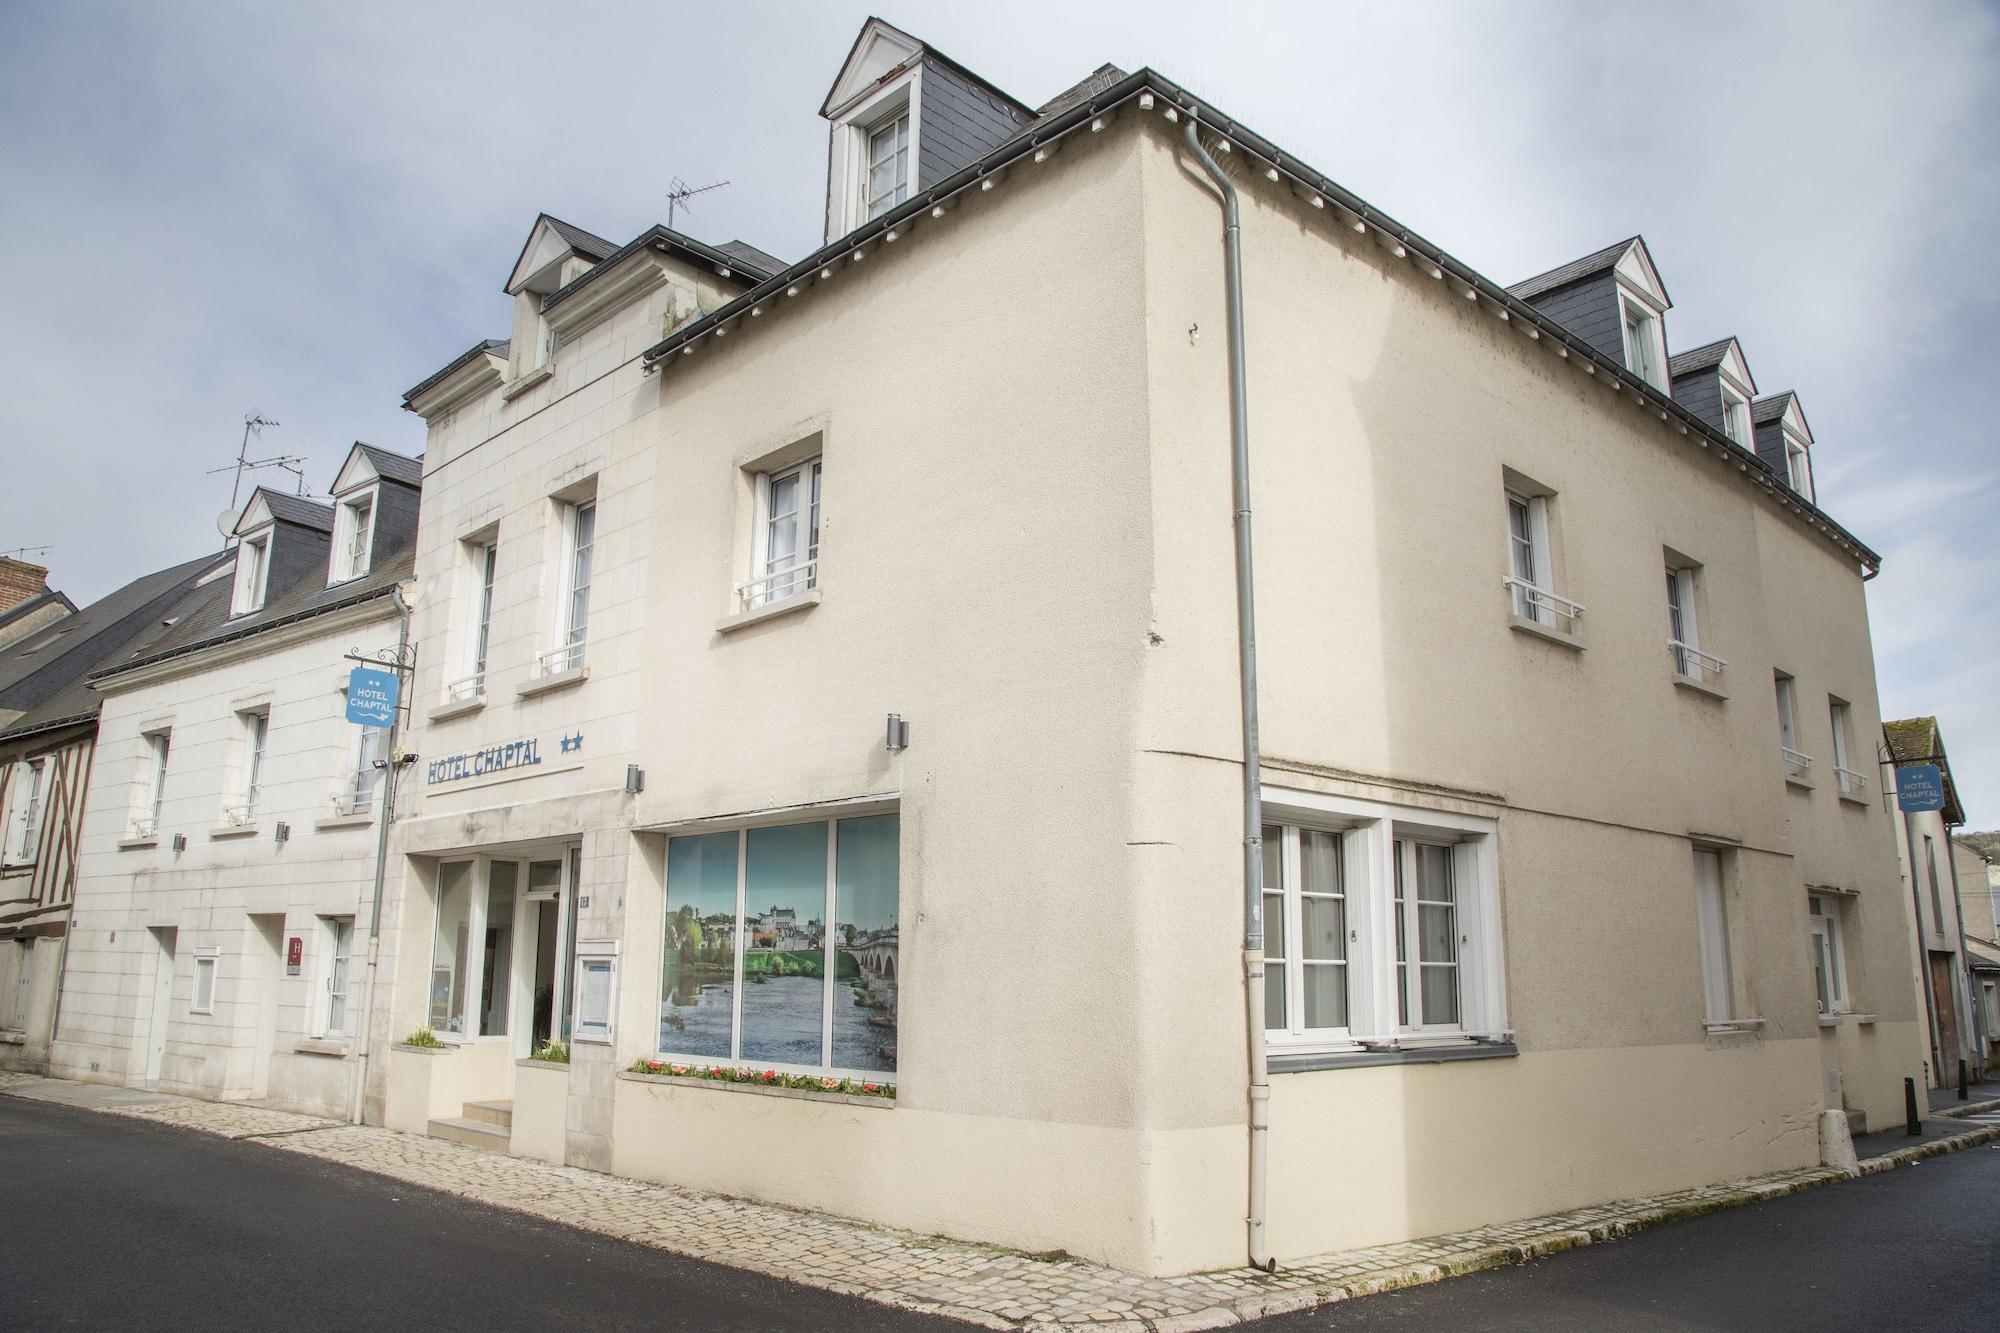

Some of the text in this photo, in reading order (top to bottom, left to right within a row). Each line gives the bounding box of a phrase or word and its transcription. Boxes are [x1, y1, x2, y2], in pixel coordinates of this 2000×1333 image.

[357, 688, 388, 701] HOTEL
[350, 697, 392, 712] CHAPTAL
[428, 738, 542, 785] HOTEL CHAPTAL
[1904, 782, 1933, 790] HOTEL
[1900, 790, 1939, 799] CHAPTAL
[294, 942, 301, 953] H
